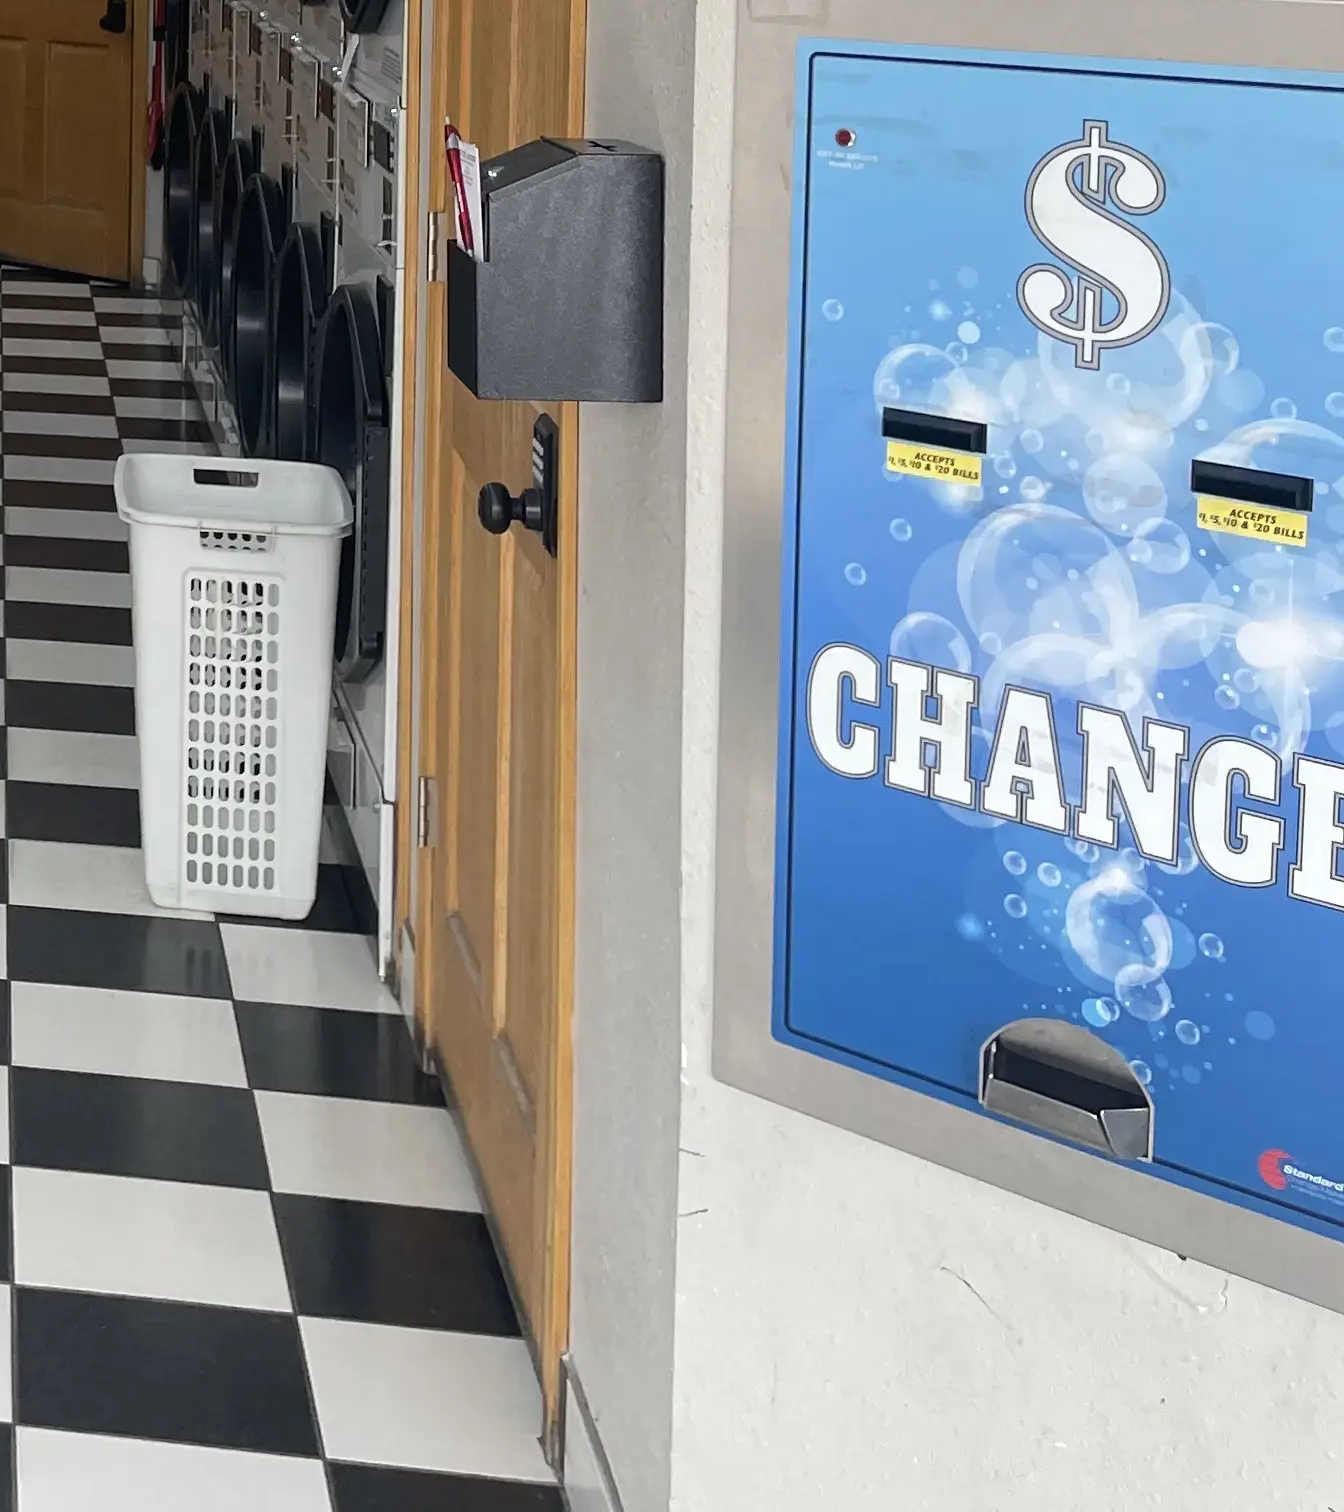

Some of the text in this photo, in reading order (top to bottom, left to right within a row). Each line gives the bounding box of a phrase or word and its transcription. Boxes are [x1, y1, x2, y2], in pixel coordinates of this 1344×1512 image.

[914, 452, 955, 466] ACCEPTS
[924, 463, 931, 471] &
[952, 468, 979, 480] BILLS
[1229, 508, 1277, 524] ACCEPTS
[1240, 520, 1248, 529] &
[1273, 526, 1305, 539] BILLS
[806, 641, 1344, 913] CHANGE
[1283, 1164, 1344, 1192] Standard
